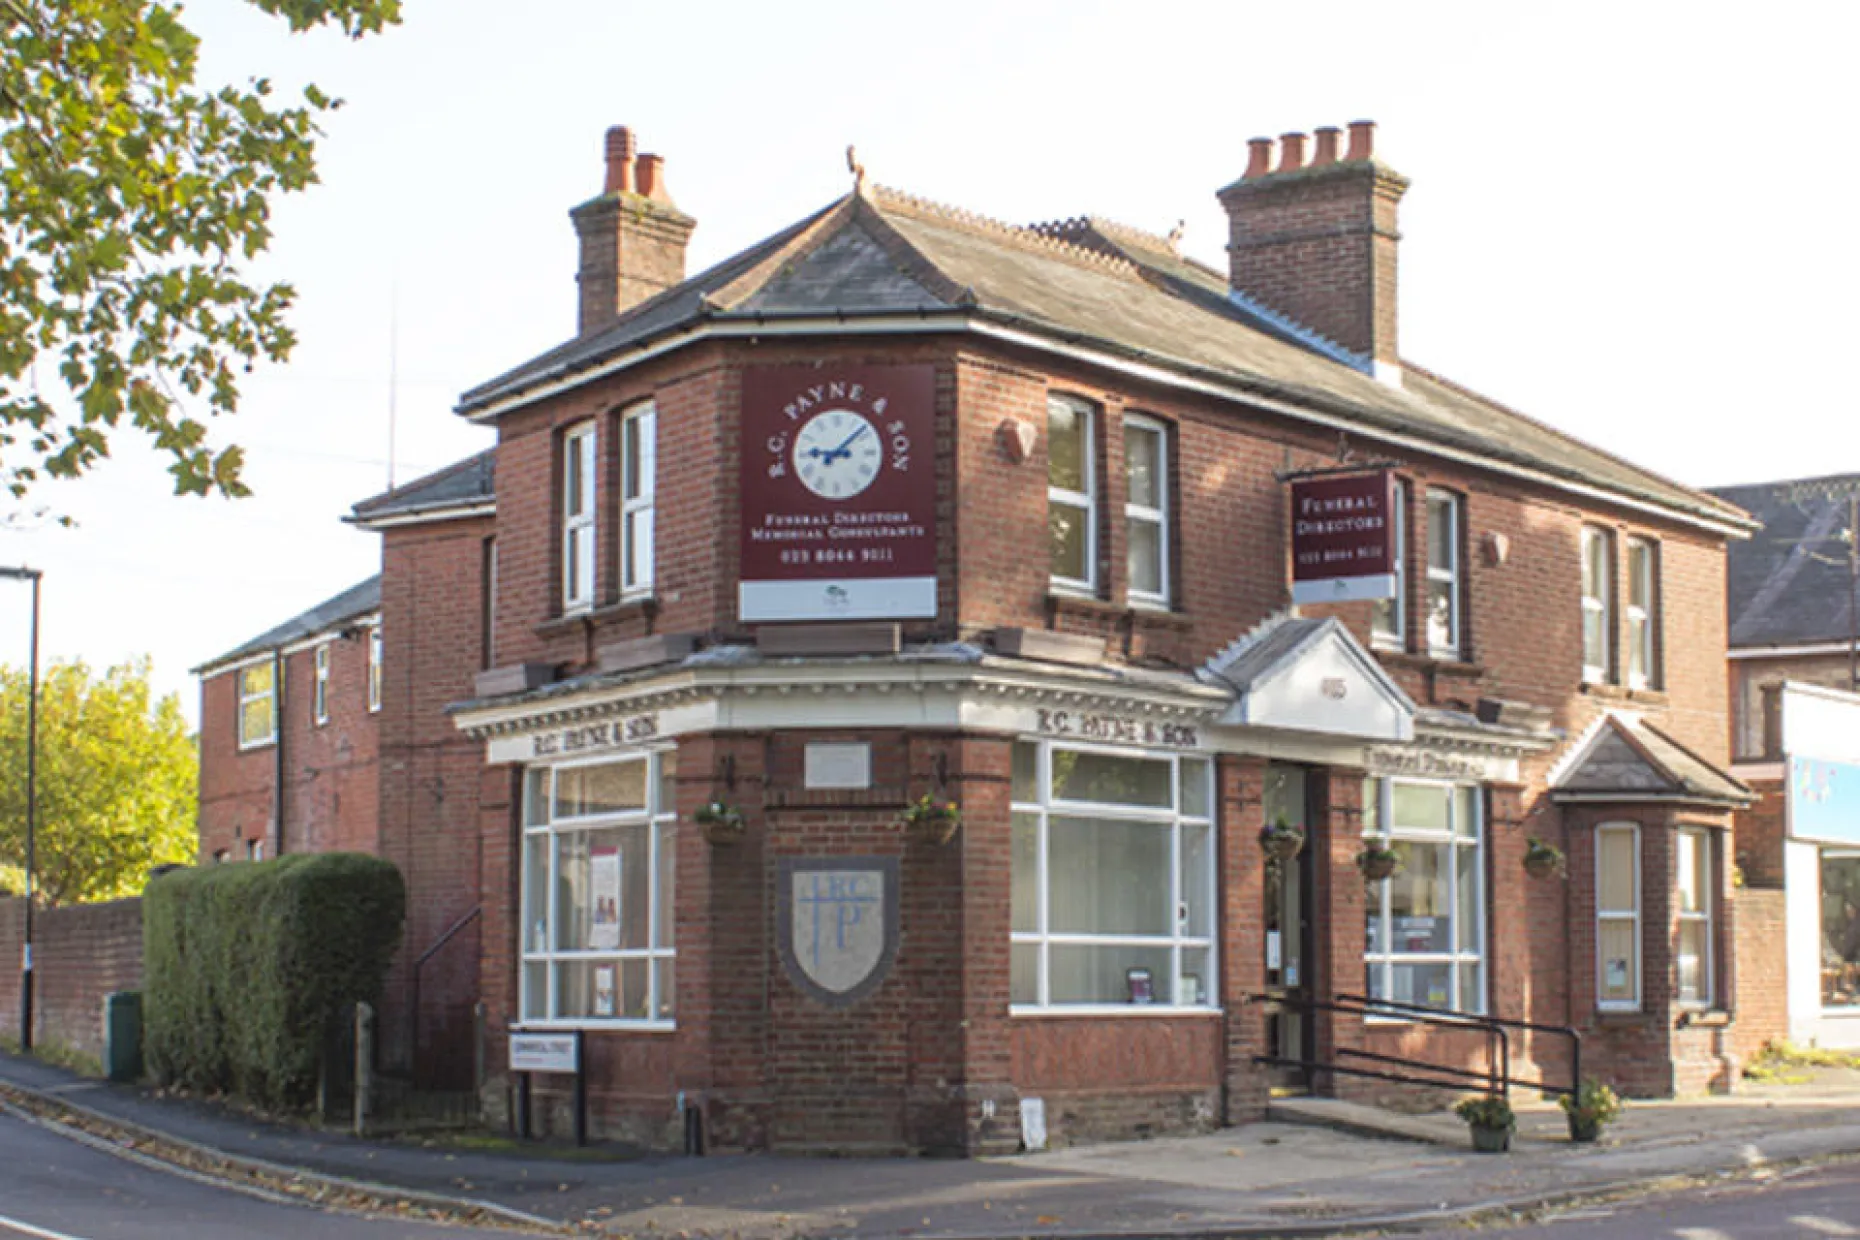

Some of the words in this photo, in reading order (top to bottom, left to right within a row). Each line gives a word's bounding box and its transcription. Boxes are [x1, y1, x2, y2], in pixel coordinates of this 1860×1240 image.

[783, 381, 864, 420] PAYNE
[886, 420, 910, 471] SON
[1302, 495, 1376, 515] FUNERAL
[764, 512, 830, 526] FUNERAL
[833, 510, 910, 525] DIRECTORS
[1295, 515, 1384, 536] DIRECTORS
[751, 527, 825, 541] MEMORIAL
